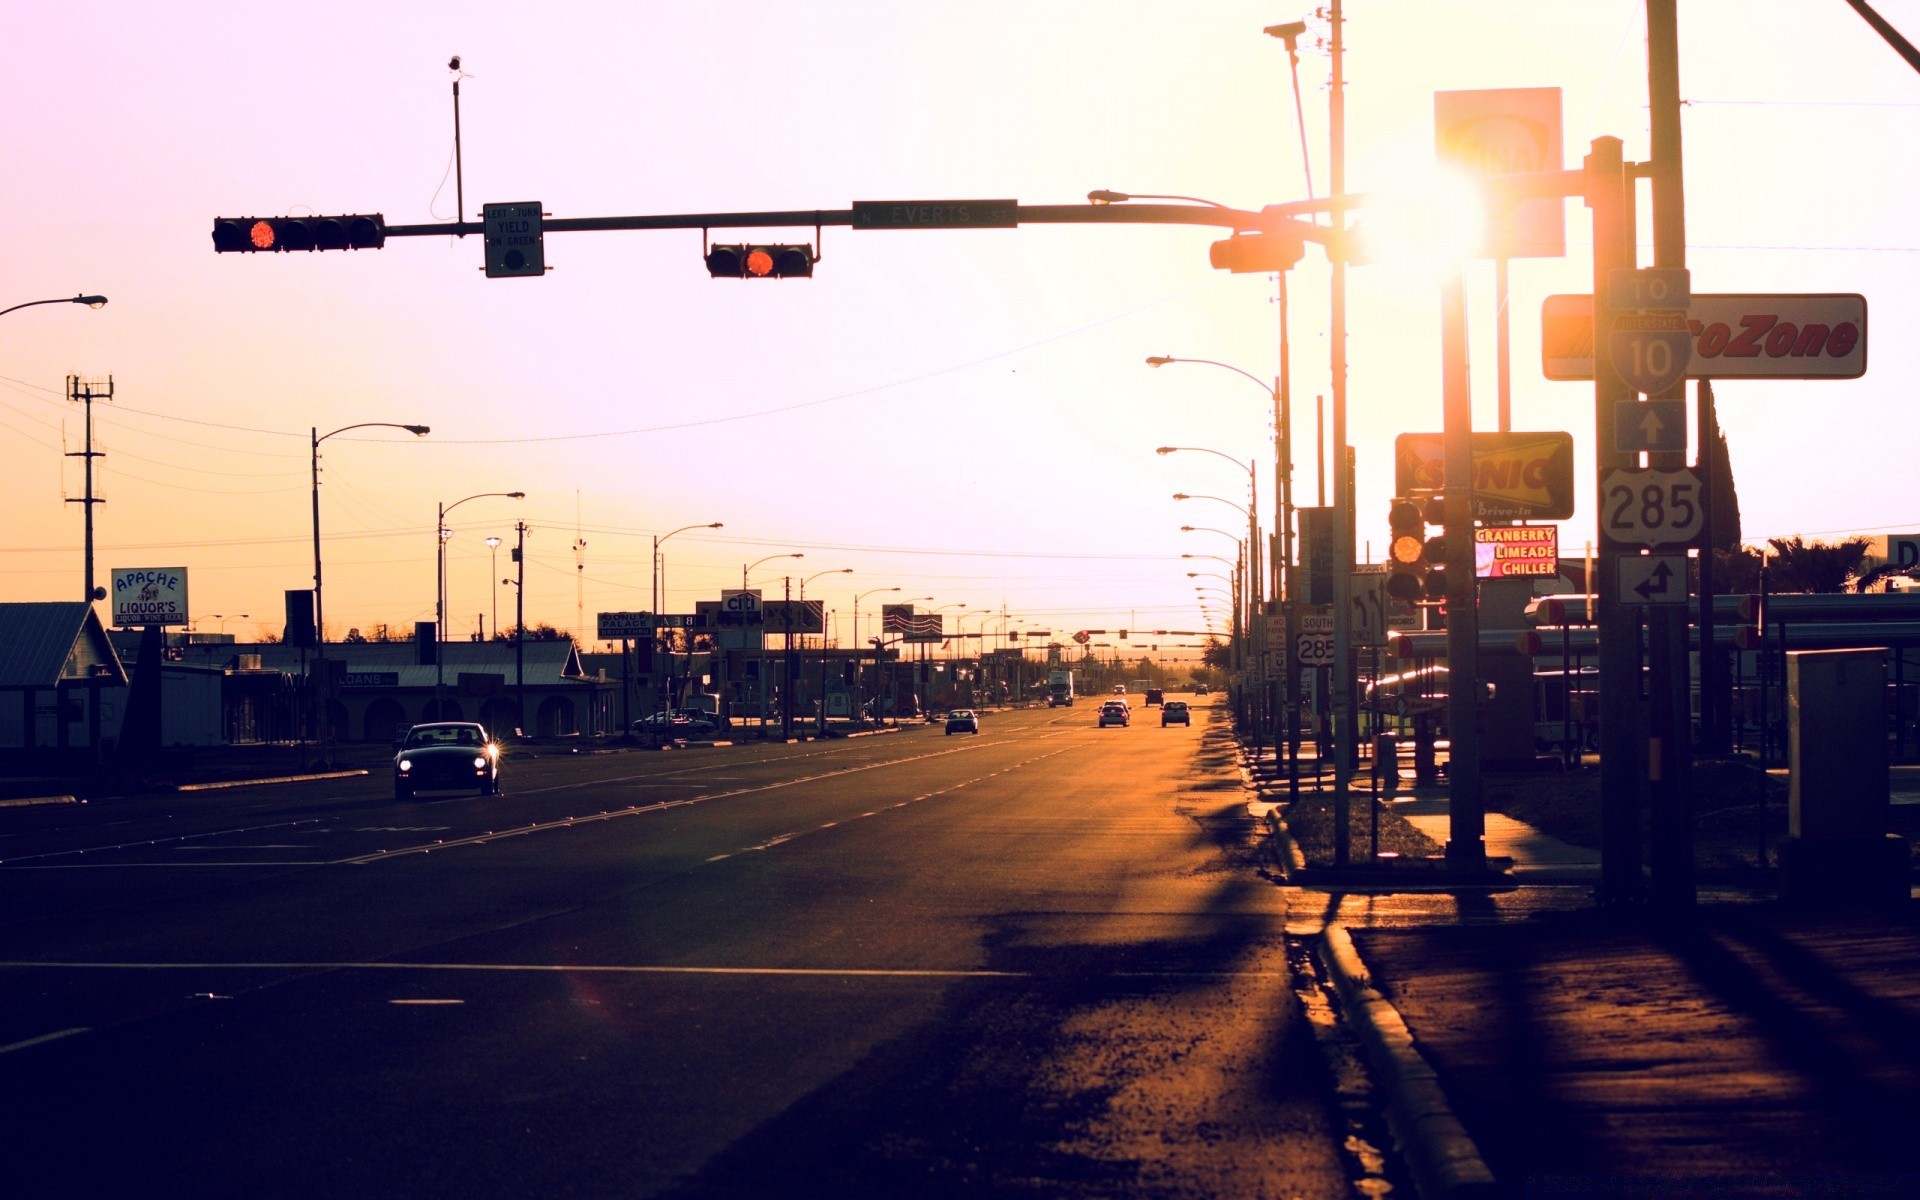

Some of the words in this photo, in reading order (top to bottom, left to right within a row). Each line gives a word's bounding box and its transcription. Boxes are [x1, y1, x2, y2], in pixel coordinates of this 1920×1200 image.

[487, 209, 507, 219] LEFT
[517, 207, 539, 217] TURN
[892, 206, 970, 223] EVERTS
[497, 220, 530, 233] YIELD
[490, 237, 502, 247] ON
[507, 236, 535, 246] GREEN
[1630, 278, 1668, 301] TO
[1631, 339, 1673, 377] 10
[1424, 457, 1558, 490] SNIC
[1477, 504, 1532, 517] Drive-In
[1609, 483, 1695, 530] 285
[1475, 528, 1554, 543] CRANBERRY
[1495, 545, 1556, 559] LIMEADE
[1501, 561, 1556, 575] CHILLER
[116, 571, 179, 592] APACHE
[120, 601, 176, 614] LIQUOR'S
[602, 620, 647, 628] PALACE
[1303, 617, 1333, 628] SOUTH
[601, 628, 624, 636] DRIVE
[1300, 640, 1335, 659] 285
[338, 674, 382, 685] LOANS
